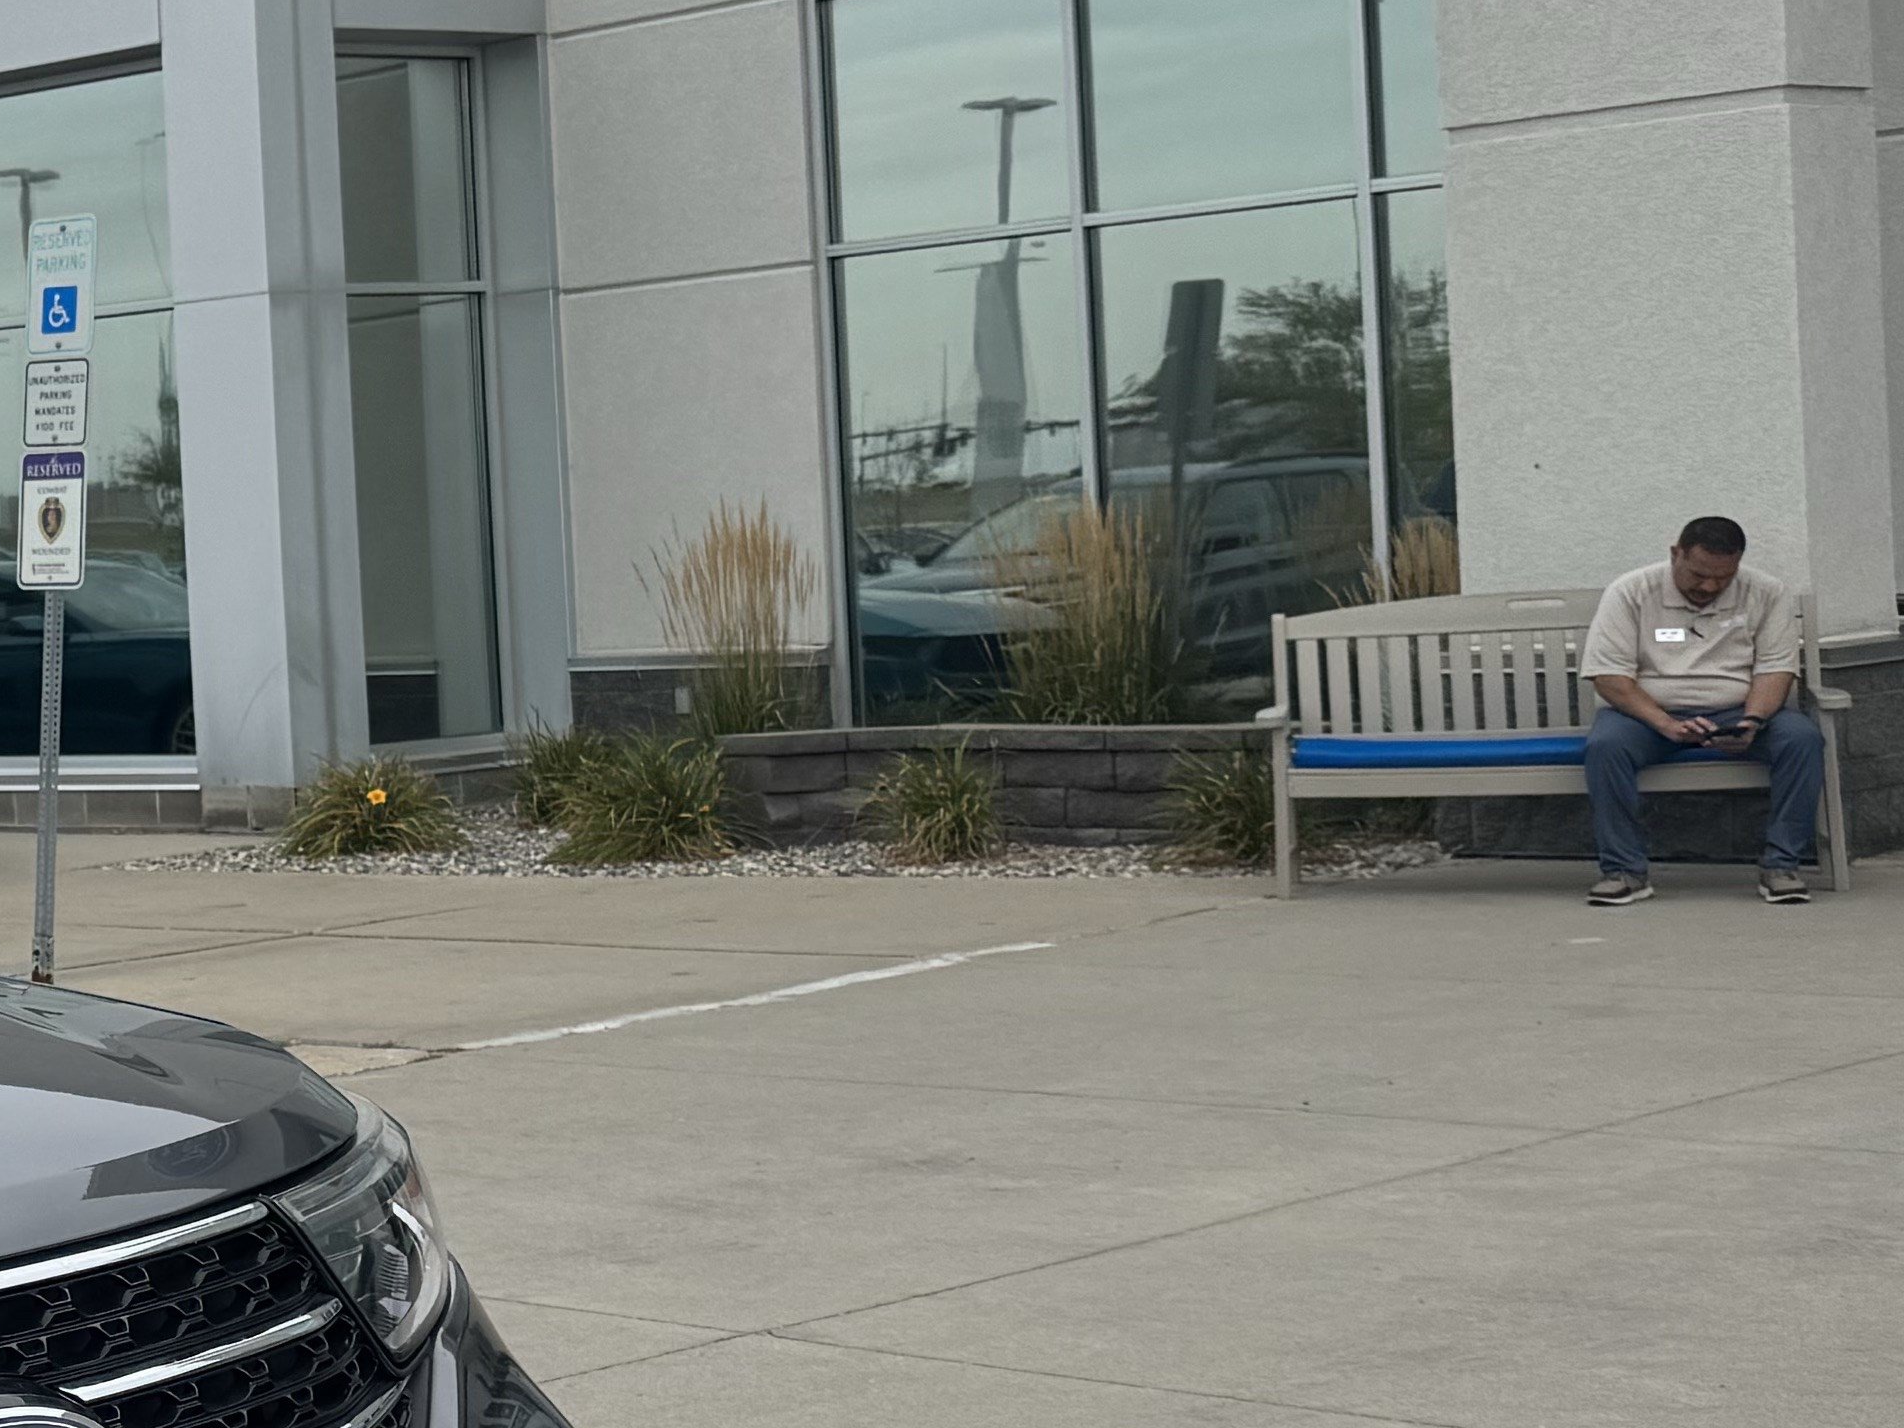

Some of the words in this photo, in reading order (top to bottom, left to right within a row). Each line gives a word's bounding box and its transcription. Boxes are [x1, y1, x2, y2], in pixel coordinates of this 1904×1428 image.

[36, 252, 87, 272] PARKING
[28, 373, 86, 386] UNAUTHORIZED
[39, 389, 72, 401] PARKING
[34, 405, 76, 416] MANDATES
[59, 420, 75, 432] FEE
[26, 462, 82, 478] RESERVED
